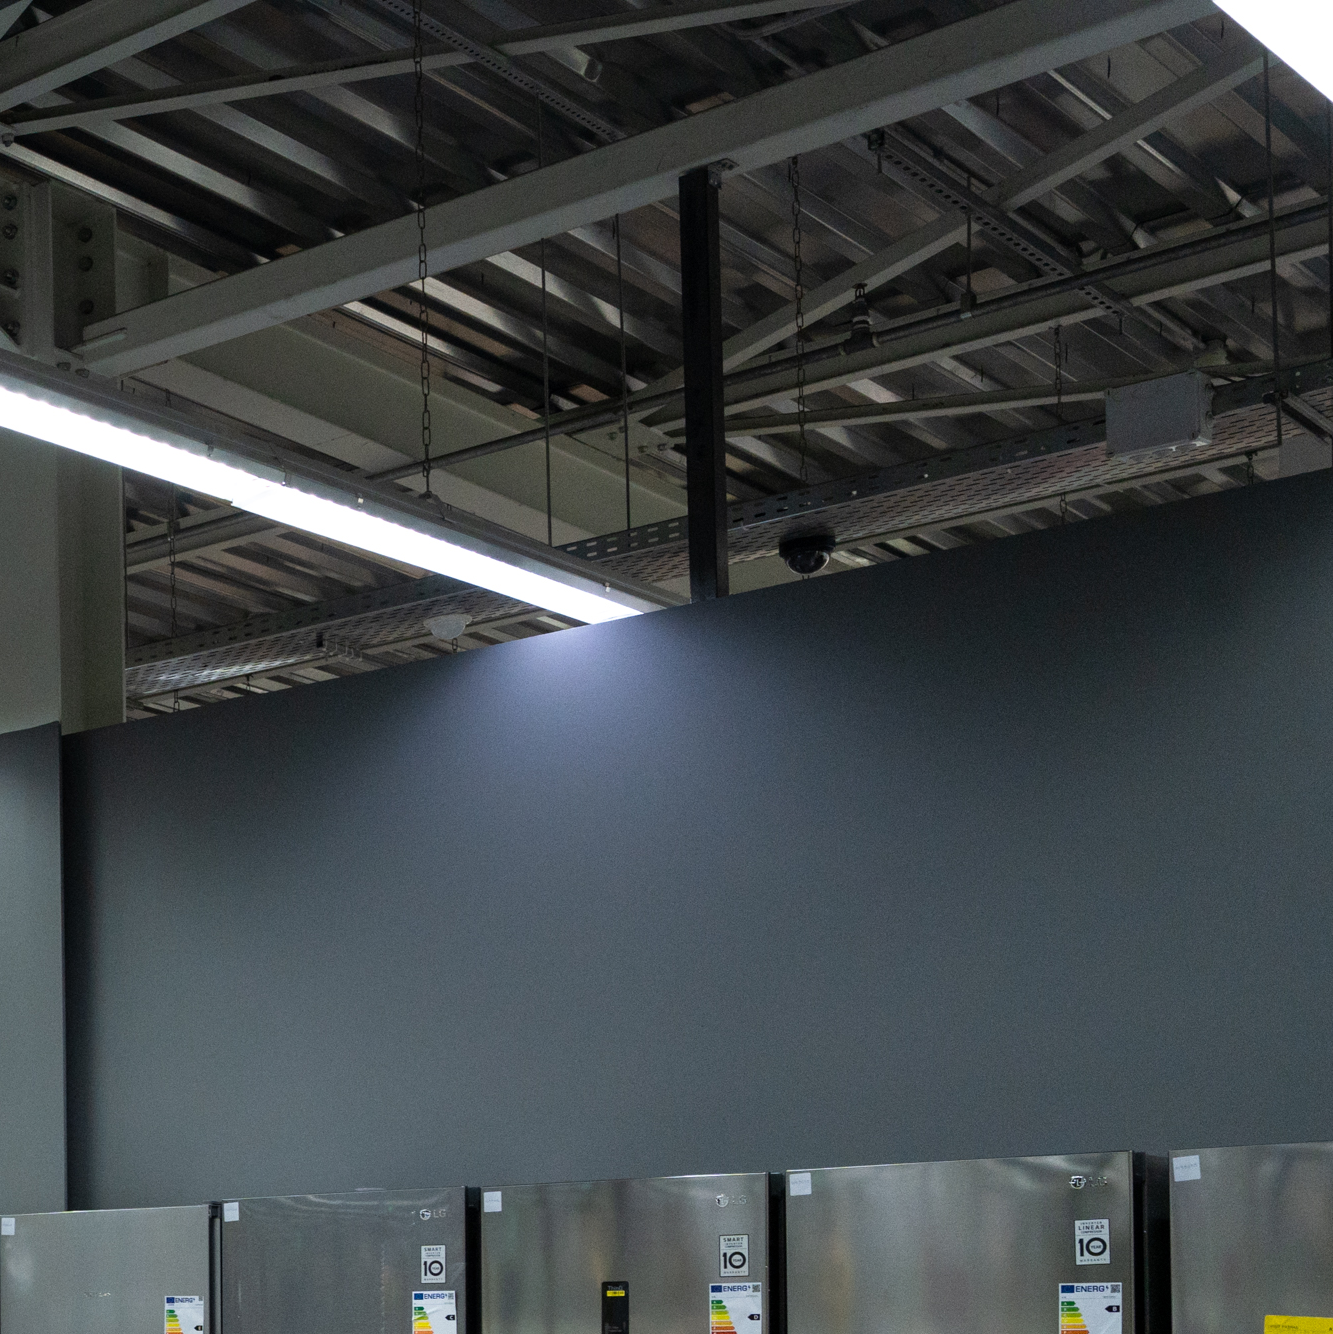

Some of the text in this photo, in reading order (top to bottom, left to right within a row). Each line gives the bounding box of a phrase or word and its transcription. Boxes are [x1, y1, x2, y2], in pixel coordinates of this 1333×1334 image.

[433, 1209, 446, 1218] LG
[1078, 1237, 1107, 1257] 10
[423, 1260, 443, 1276] 10
[722, 1251, 746, 1269] 10
